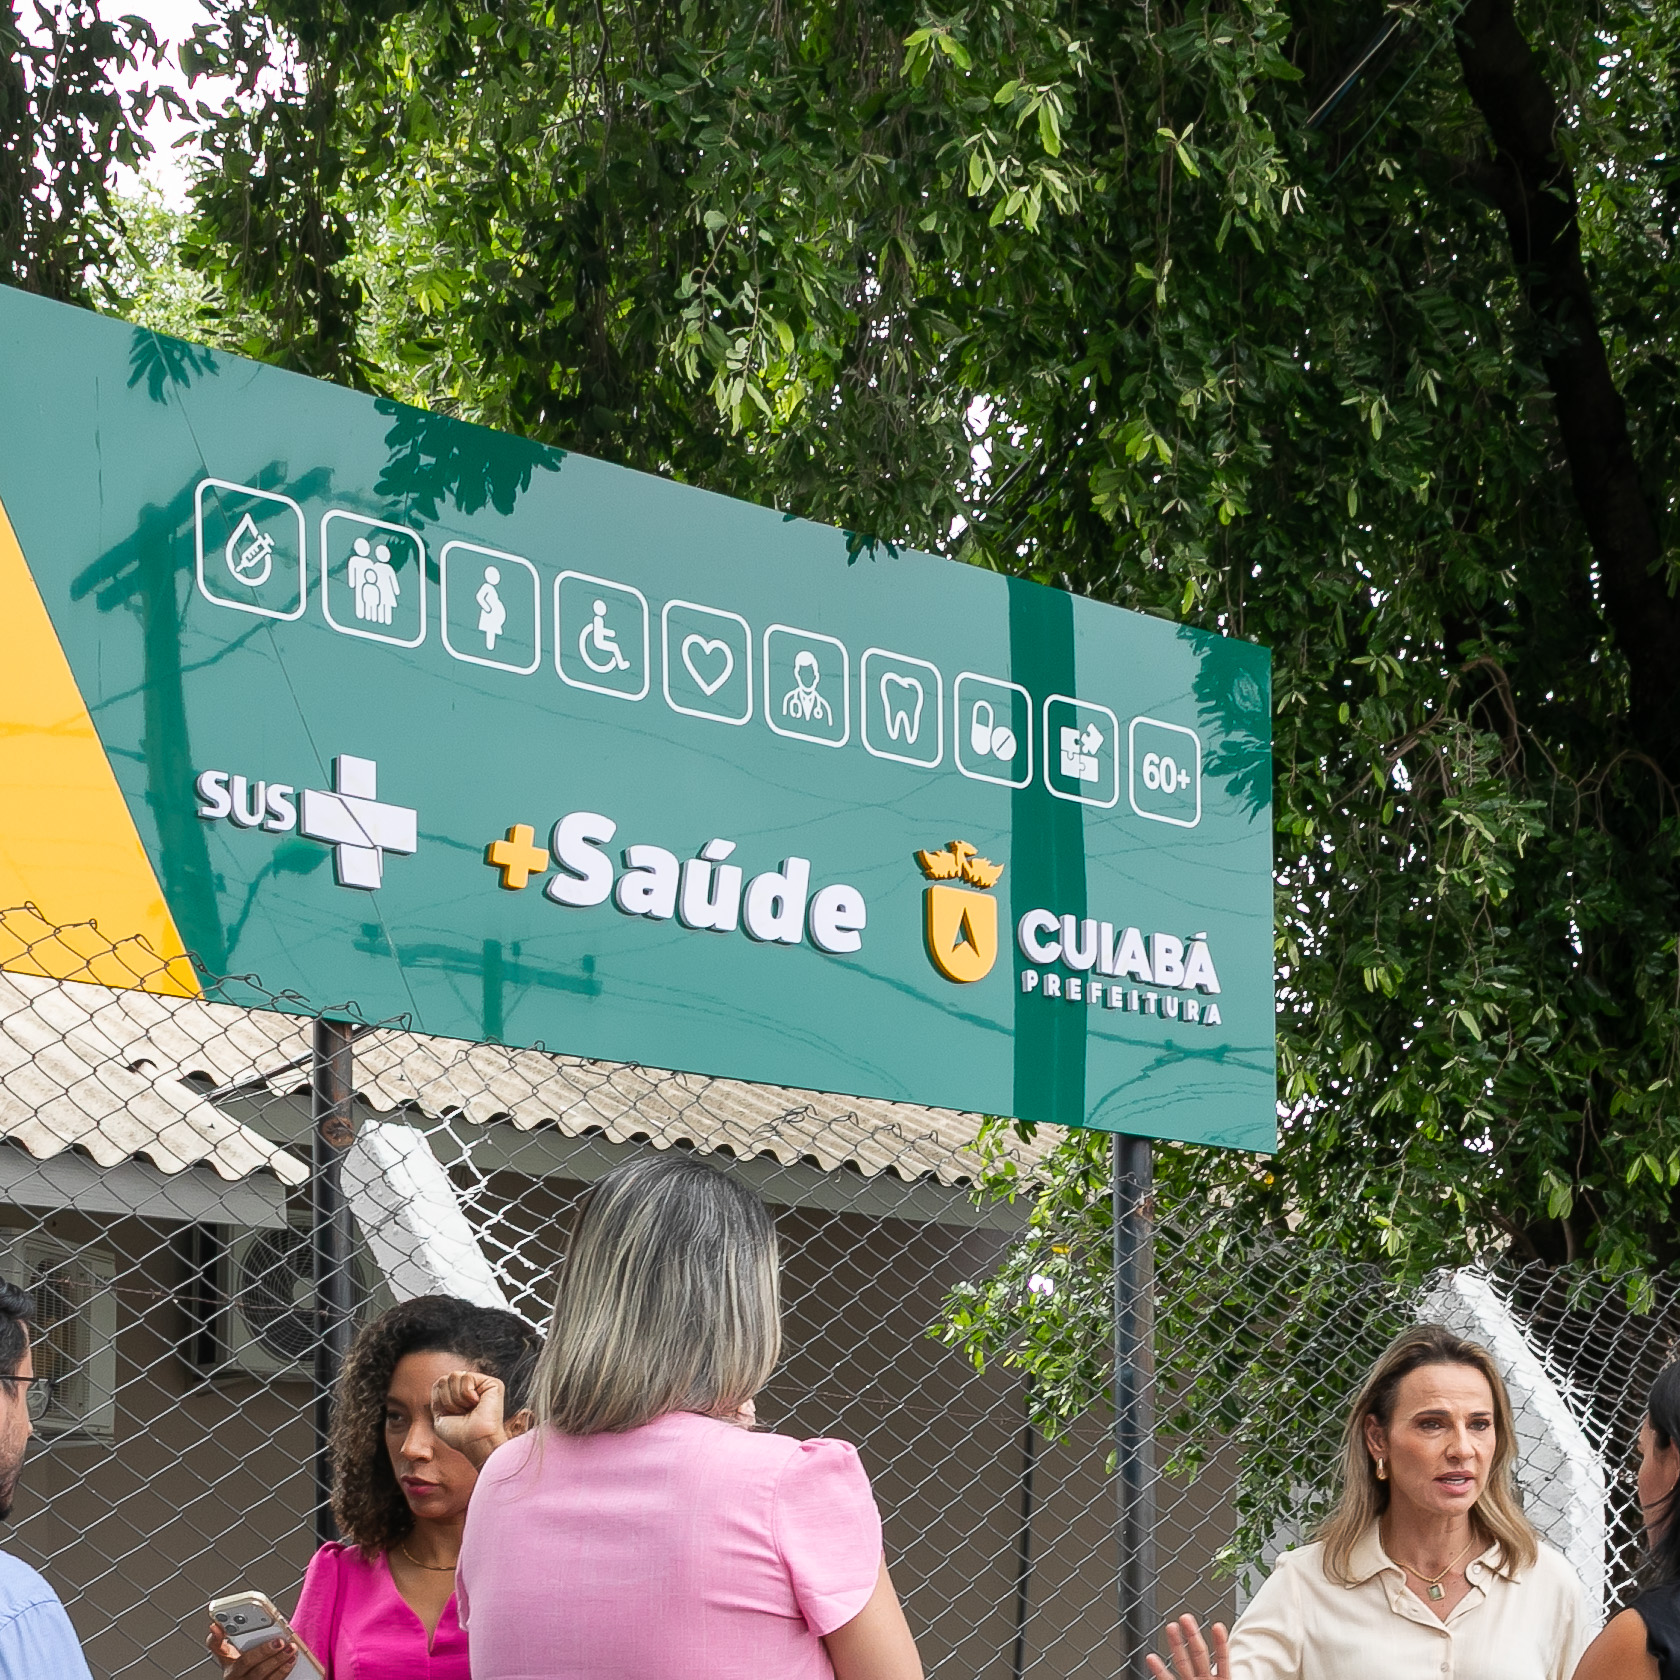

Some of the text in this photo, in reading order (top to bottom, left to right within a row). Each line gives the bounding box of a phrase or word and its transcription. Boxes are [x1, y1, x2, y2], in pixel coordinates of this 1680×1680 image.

[196, 769, 297, 833] SUS
[1143, 752, 1191, 794] 60+
[1018, 907, 1222, 995] CUIABÁ
[1022, 969, 1222, 1026] PREFEITURA
